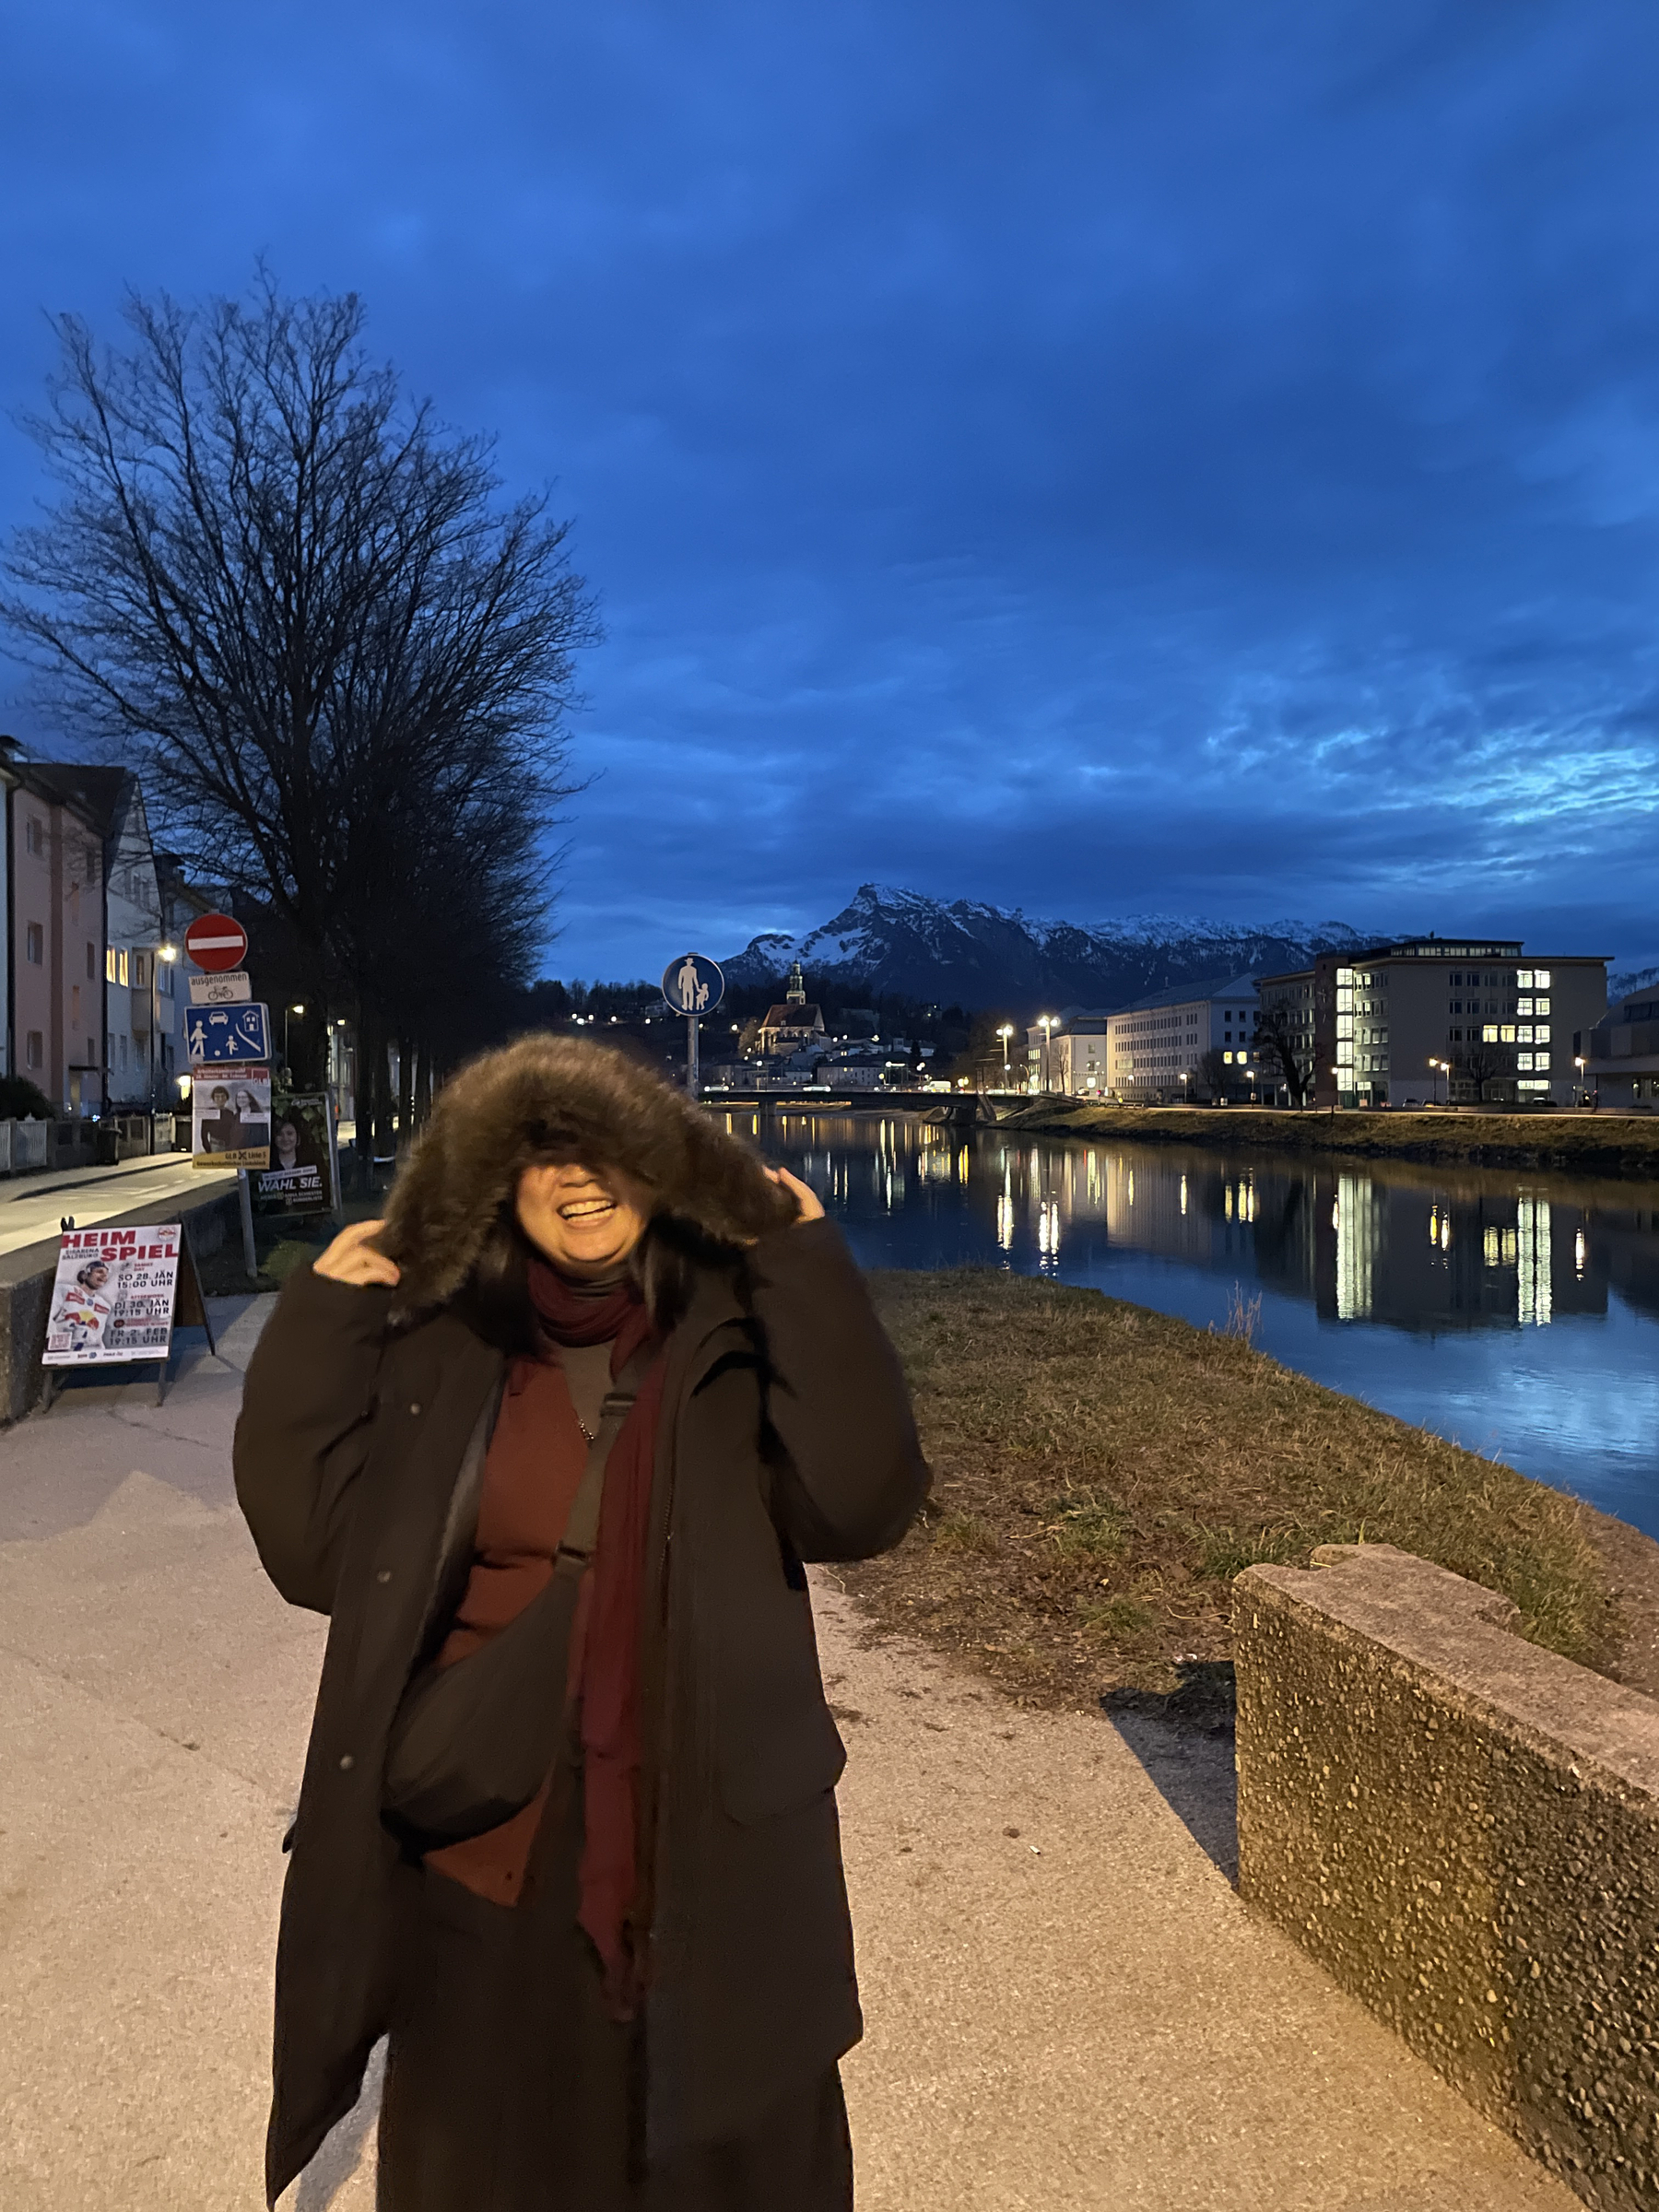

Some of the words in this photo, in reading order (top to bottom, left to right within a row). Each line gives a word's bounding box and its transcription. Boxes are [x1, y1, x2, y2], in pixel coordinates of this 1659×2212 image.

[191, 973, 247, 986] ausgenommen
[300, 1176, 323, 1188] SIE.
[61, 1230, 135, 1248] HEIM
[100, 1244, 179, 1262] SPIEL
[155, 1270, 173, 1279] JÄN
[117, 1280, 147, 1288] 15:00
[149, 1298, 170, 1307] JÄN
[146, 1307, 170, 1315] UHR
[111, 1329, 124, 1337] FR
[146, 1327, 168, 1335] FEB
[142, 1335, 166, 1344] UHR
